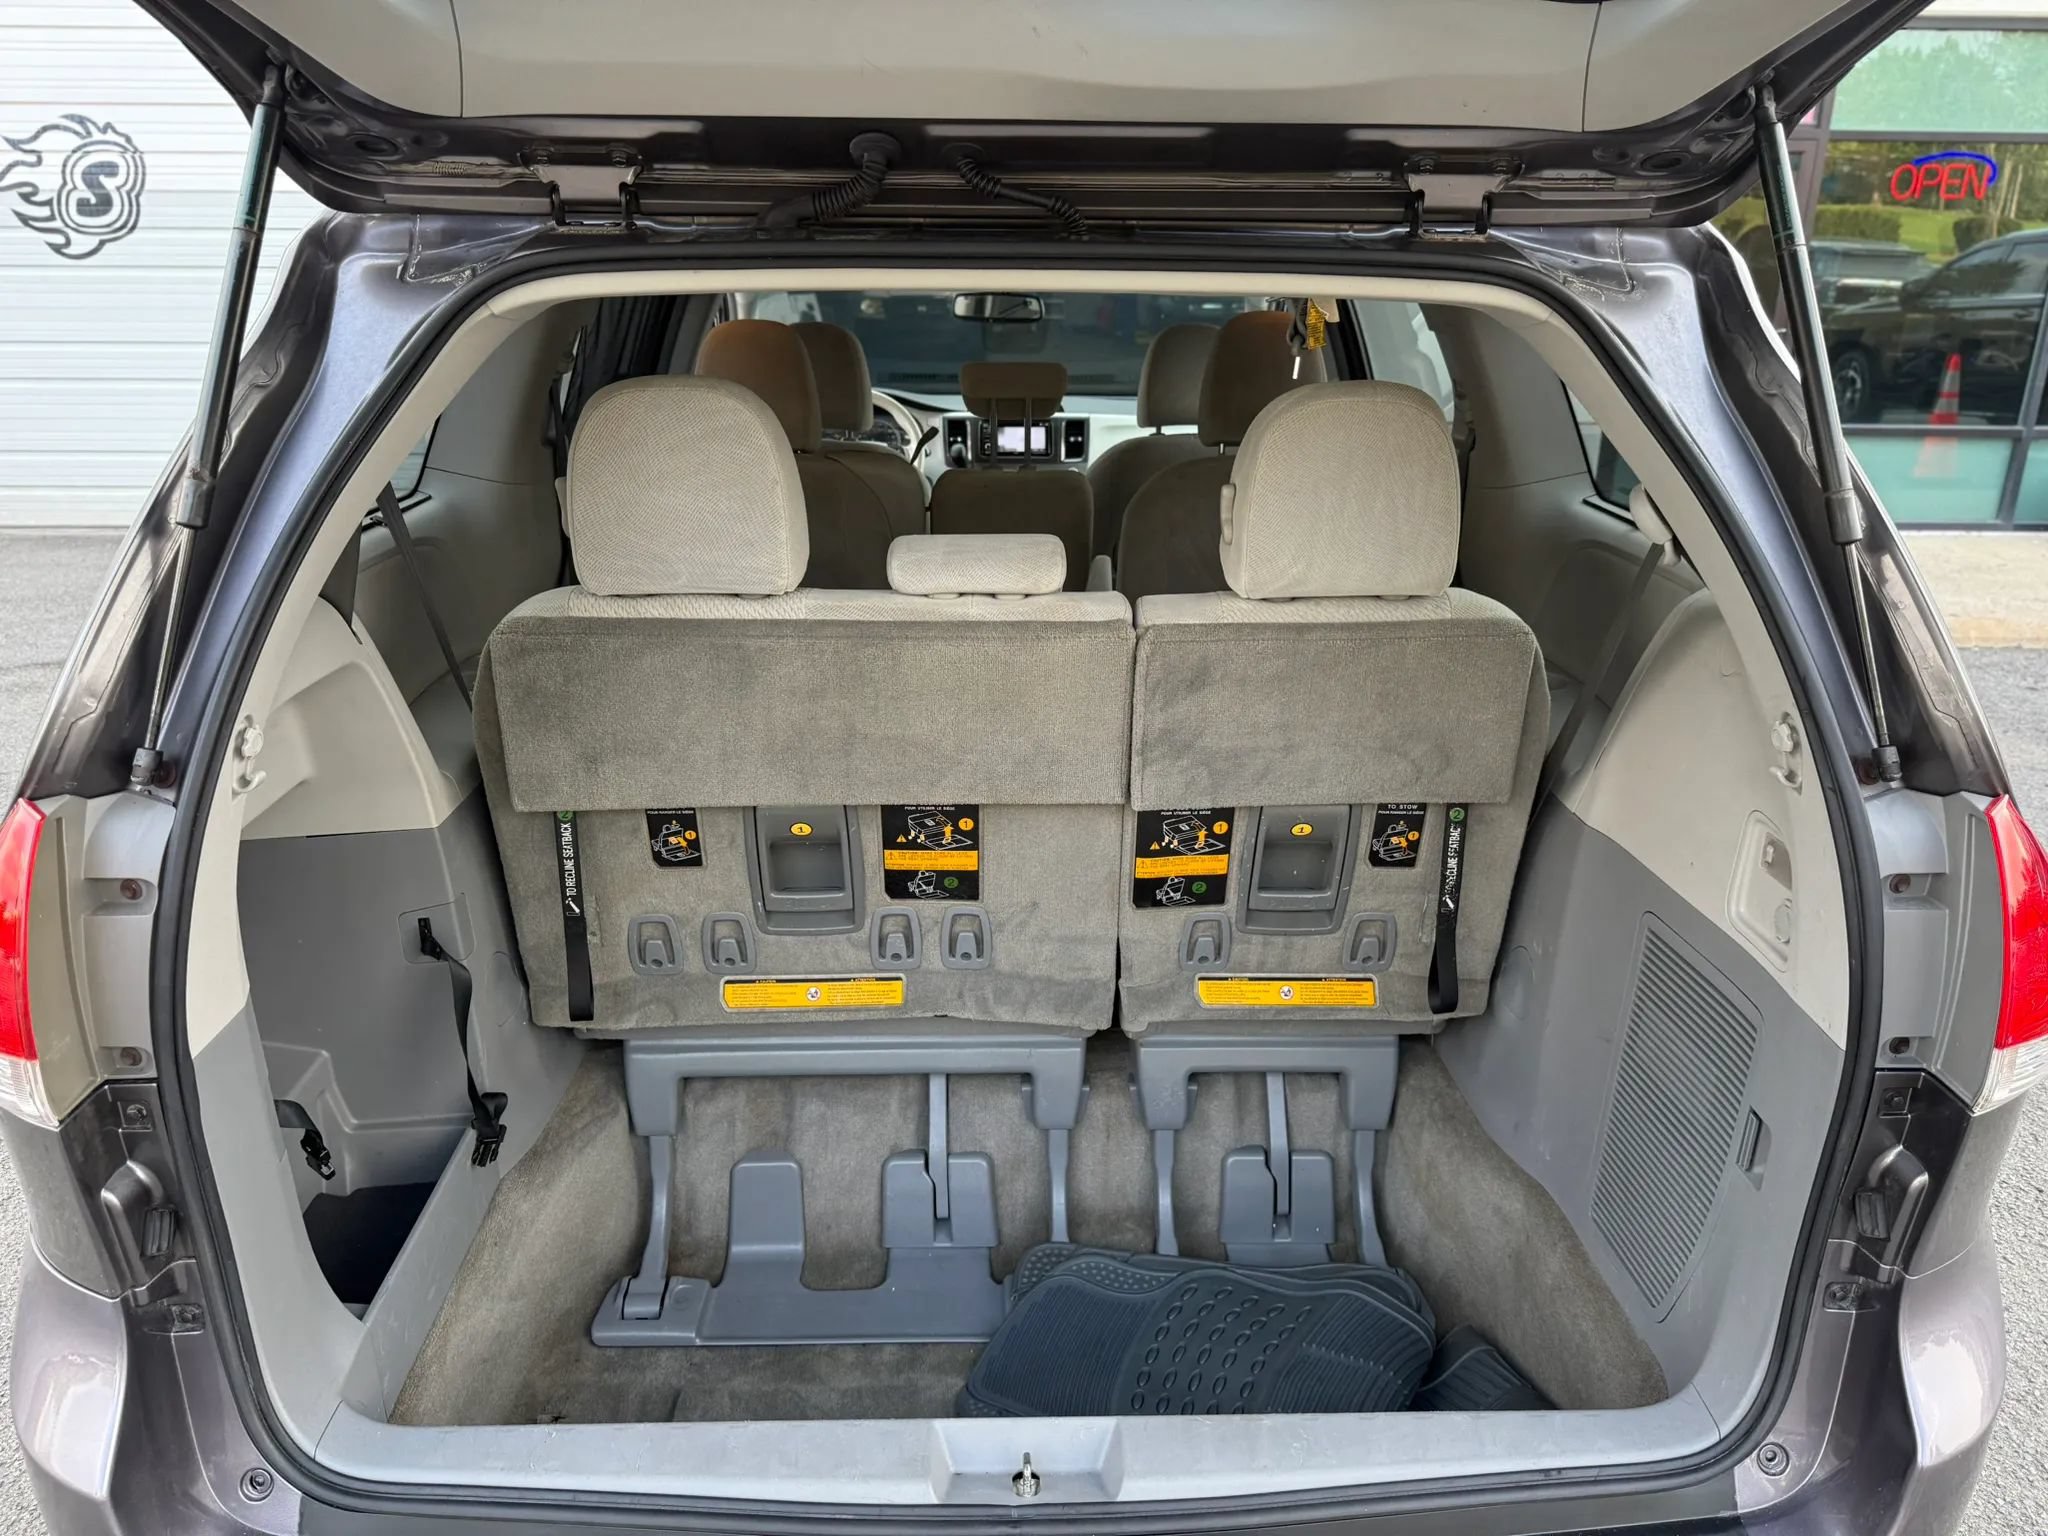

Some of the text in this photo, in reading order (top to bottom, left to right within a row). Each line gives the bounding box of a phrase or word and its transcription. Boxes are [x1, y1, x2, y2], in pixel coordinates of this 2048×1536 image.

[76, 160, 120, 218] S
[1890, 163, 1991, 201] OPEN
[1452, 809, 1460, 819] 2
[560, 822, 577, 897] TO RECLINE SEATBACK
